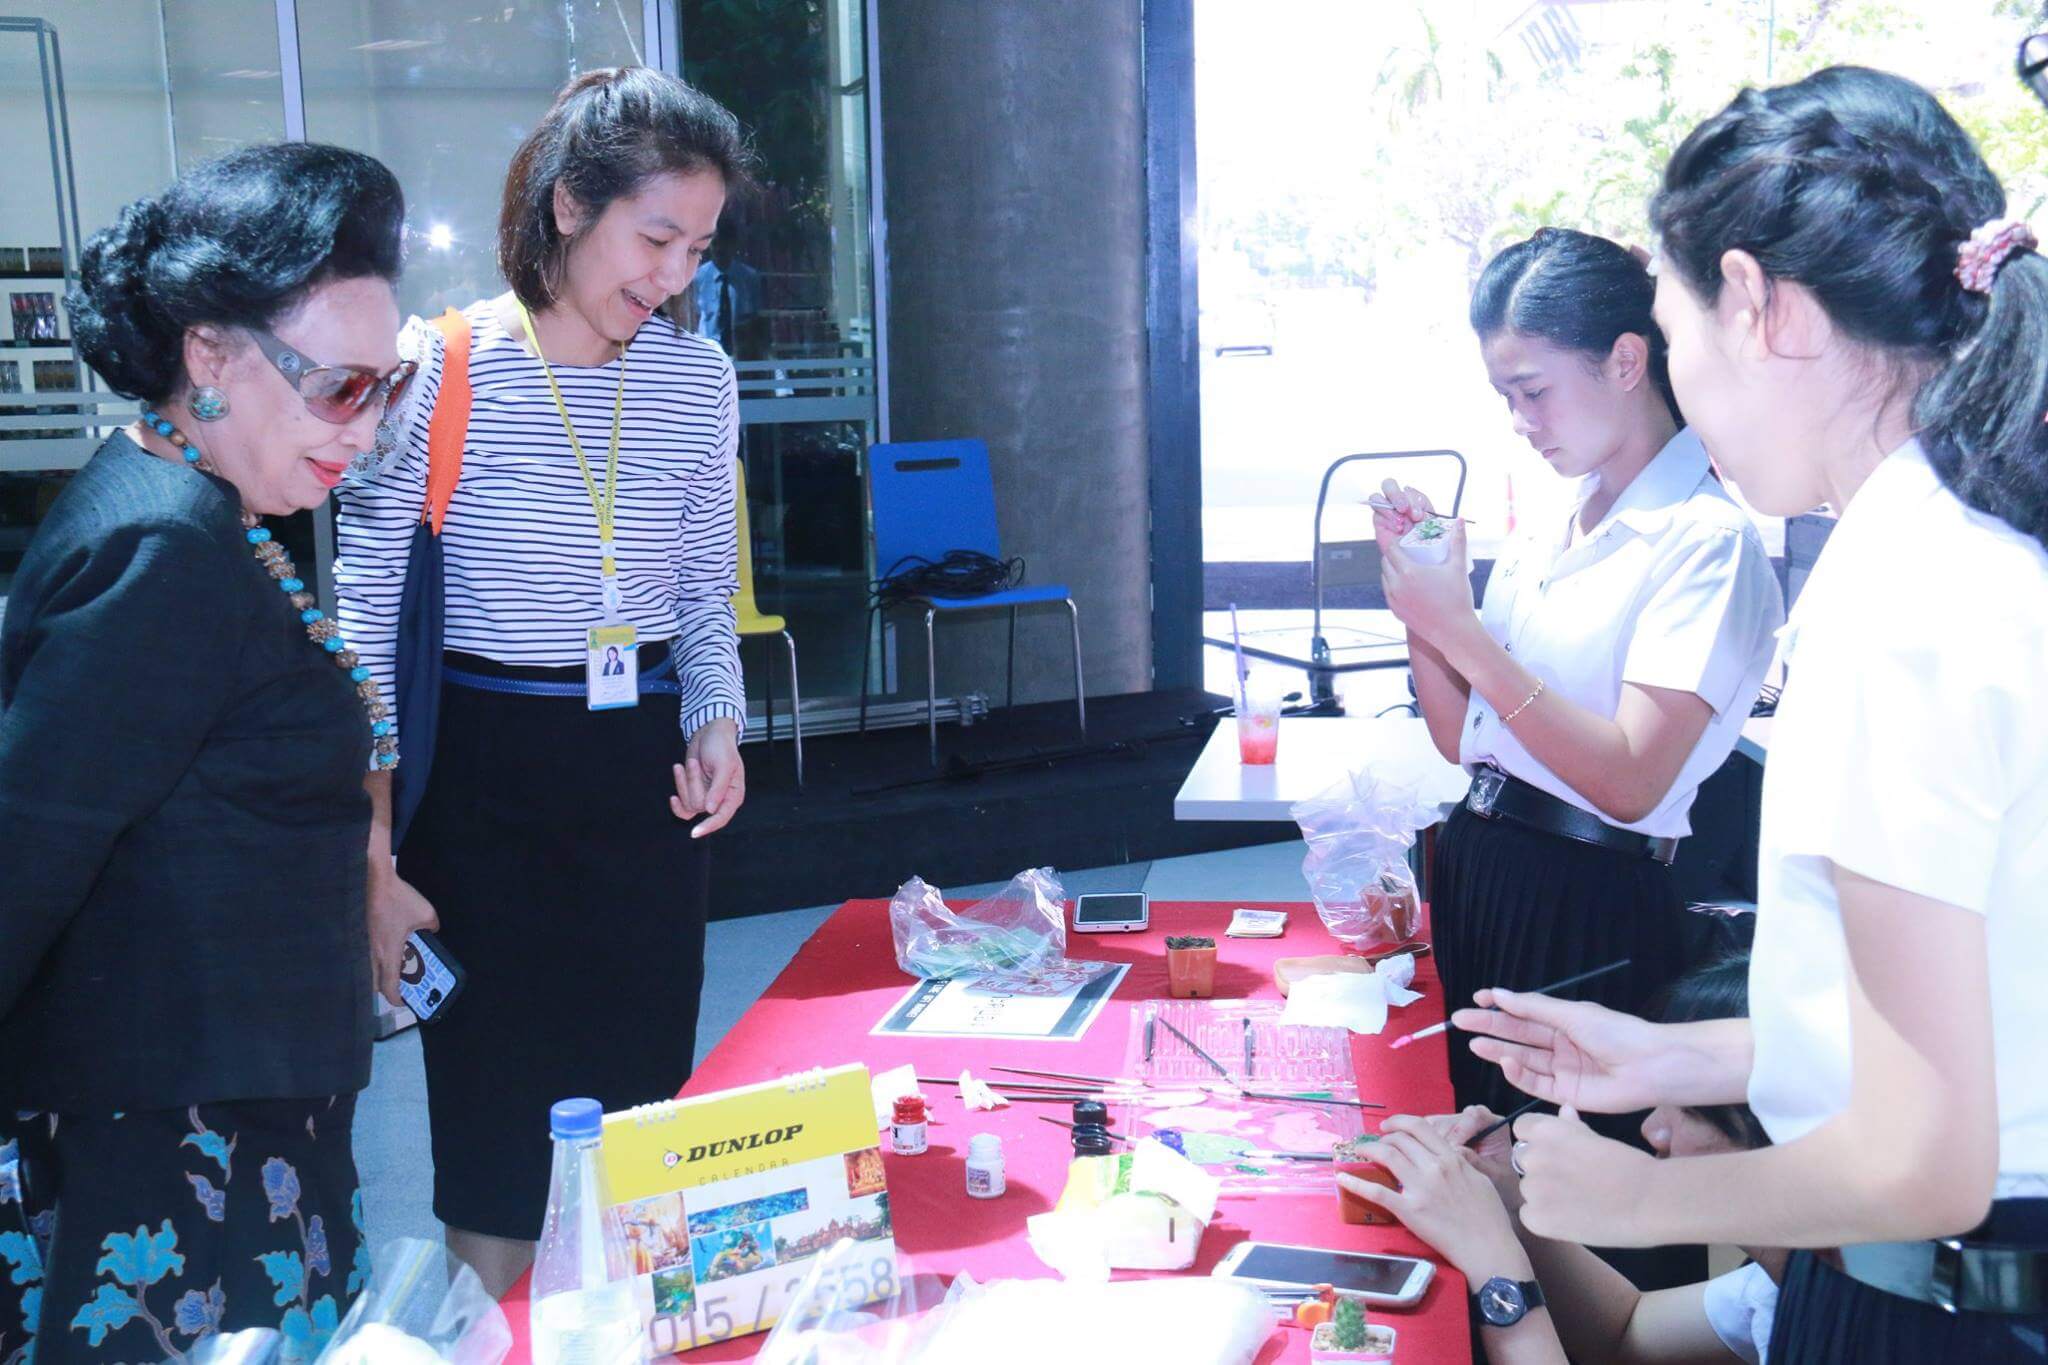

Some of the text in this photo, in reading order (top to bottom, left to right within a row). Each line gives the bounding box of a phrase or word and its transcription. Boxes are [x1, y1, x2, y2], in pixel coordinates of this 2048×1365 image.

[686, 1124, 804, 1163] DUNLOP
[699, 1158, 790, 1186] CALENDAR
[641, 1296, 733, 1354] 015
